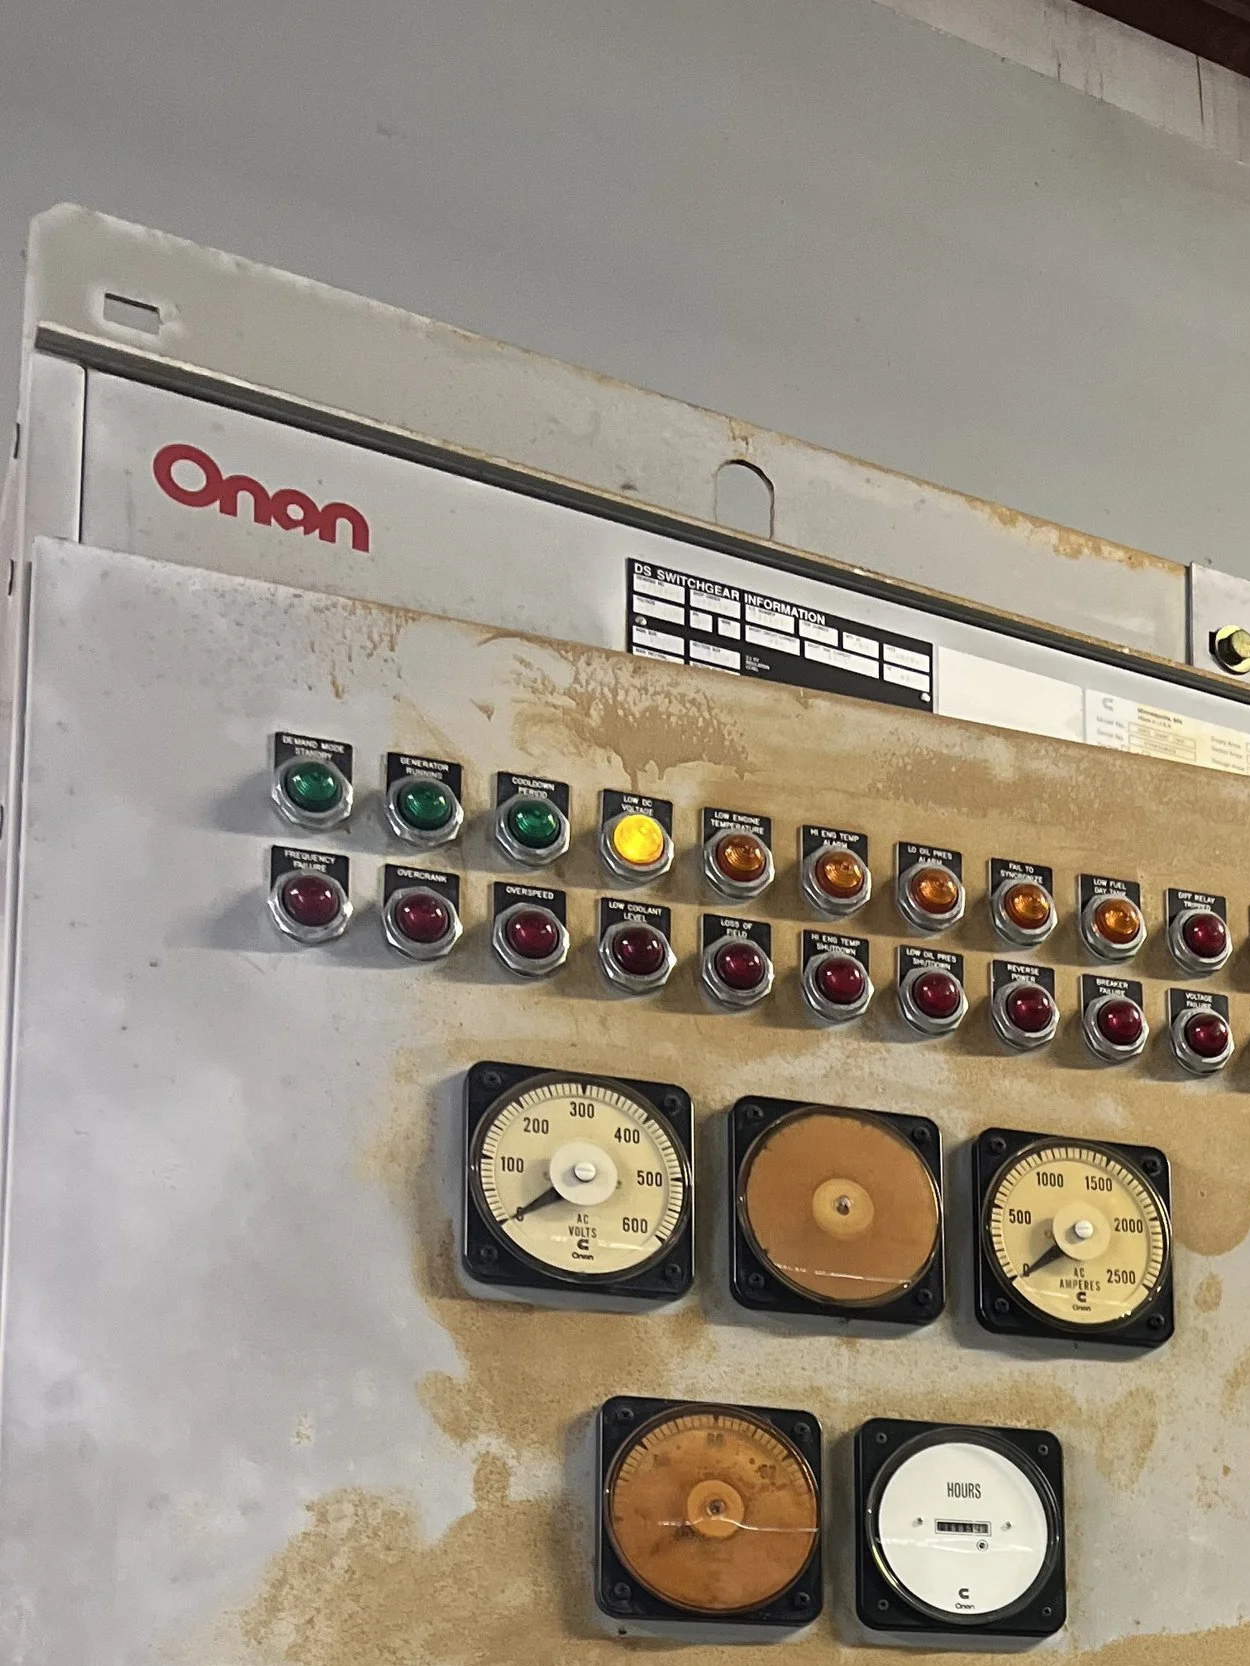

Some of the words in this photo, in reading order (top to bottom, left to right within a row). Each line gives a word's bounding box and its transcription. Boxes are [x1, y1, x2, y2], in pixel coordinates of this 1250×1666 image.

[153, 443, 369, 553] Onan
[635, 562, 652, 577] DS
[657, 569, 739, 601] SWITCHGEAR
[744, 593, 825, 624] INFORMATION
[400, 758, 449, 771] GENERATOR
[512, 777, 555, 791] COOLDOWN
[714, 812, 730, 820] LOW
[733, 814, 760, 825] ENGINE
[810, 828, 819, 836] HI
[821, 830, 837, 839] ENG
[840, 833, 859, 842] TEMP
[284, 850, 335, 864] FREQUENCY
[398, 869, 447, 883] OVERCRANK
[506, 886, 554, 900] OVERSPEED
[609, 901, 625, 910] LOW
[628, 904, 662, 916] COOLANT
[811, 933, 819, 941] HI
[822, 935, 838, 944] ENG
[840, 938, 860, 947] TEMP
[1008, 964, 1039, 976] REVERSE
[1096, 978, 1129, 989] BREAKER
[1185, 992, 1212, 1003] VOLTAGE
[570, 1102, 594, 1118] 300
[523, 1118, 549, 1134] 200
[614, 1127, 640, 1144] 400
[501, 1157, 524, 1173] 100
[637, 1170, 662, 1187] 500
[1037, 1172, 1064, 1187] 1000
[1085, 1176, 1112, 1191] 1500
[1009, 1209, 1031, 1224] 500
[568, 1227, 596, 1238] VOLTS
[622, 1218, 648, 1234] 600
[1114, 1218, 1143, 1233] 2000
[1107, 1269, 1136, 1284] 2500
[1059, 1279, 1100, 1291] AMPERES
[947, 1482, 982, 1500] HOURS
